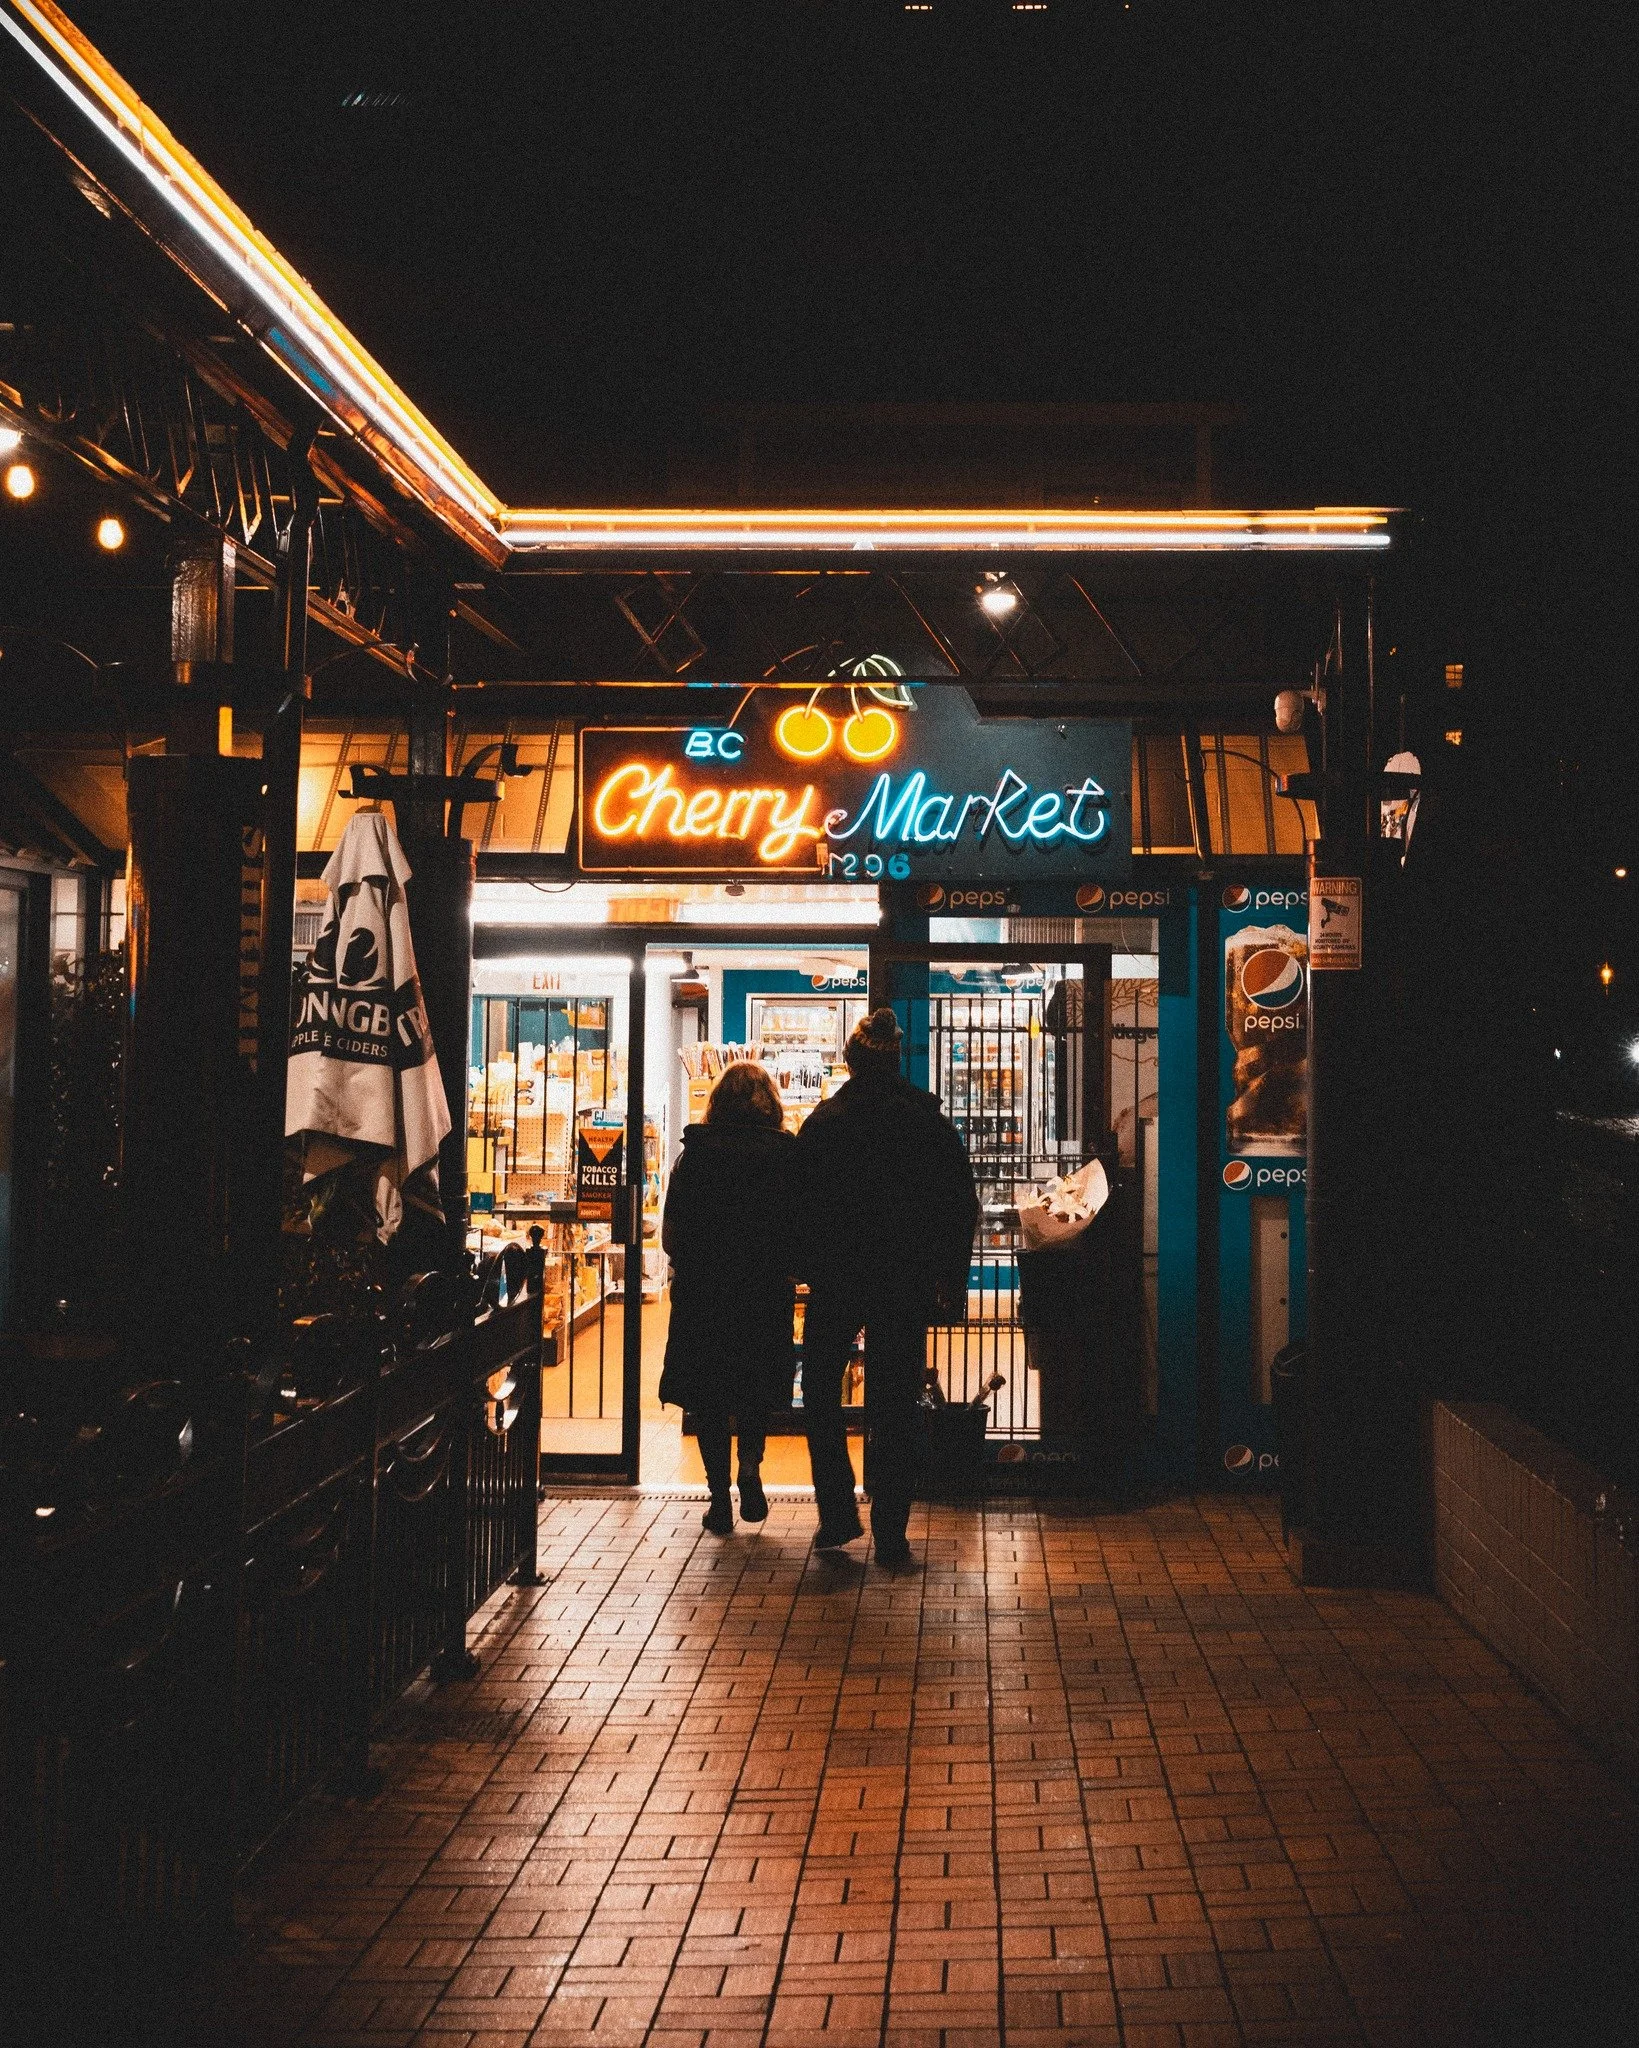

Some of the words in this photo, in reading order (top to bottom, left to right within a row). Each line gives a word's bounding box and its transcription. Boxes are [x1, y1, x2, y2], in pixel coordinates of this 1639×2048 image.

[593, 762, 820, 862] Cherry
[824, 768, 1106, 842] Market
[828, 852, 912, 881] 1296
[1313, 881, 1357, 895] WARNING
[949, 889, 1006, 910] peps
[1108, 888, 1171, 910] pepsi
[1255, 891, 1308, 911] peps
[1244, 1013, 1301, 1033] pepsi
[336, 1037, 388, 1058] CIDERS
[582, 1165, 618, 1174] TOBACCO
[1256, 1168, 1307, 1188] peps
[581, 1174, 617, 1186] KILLS
